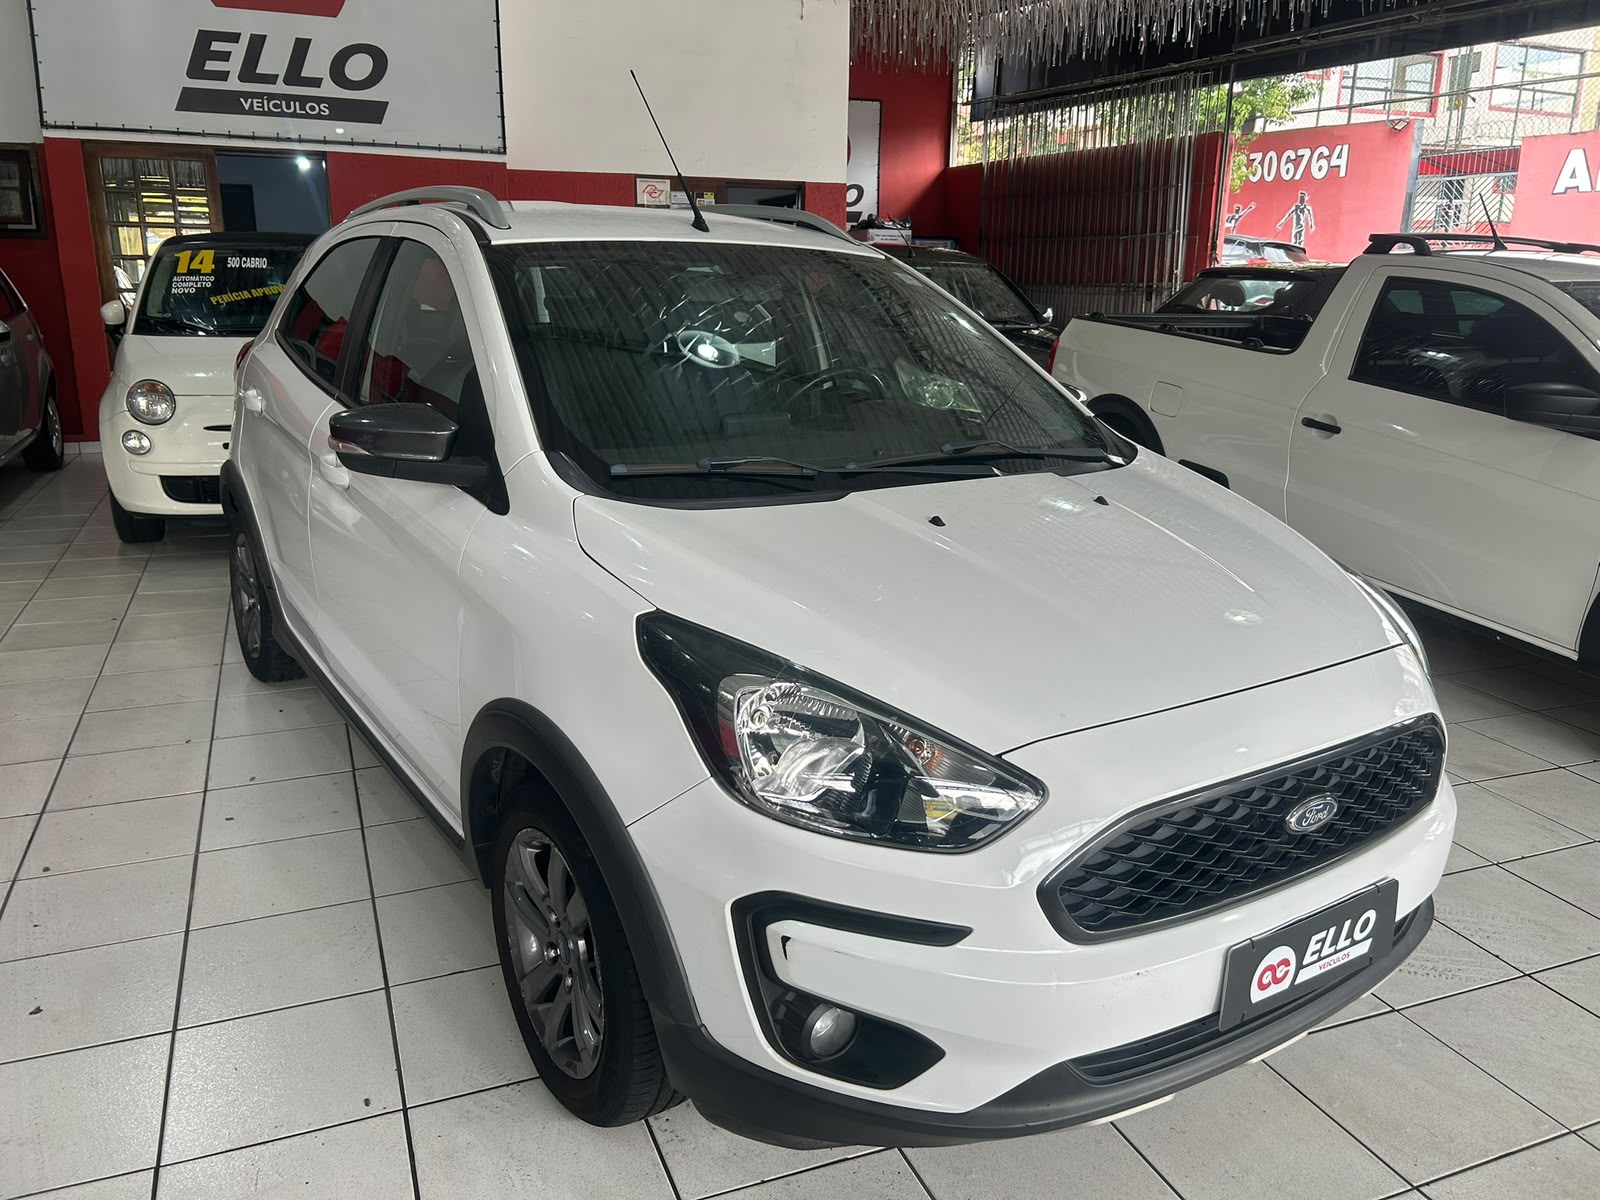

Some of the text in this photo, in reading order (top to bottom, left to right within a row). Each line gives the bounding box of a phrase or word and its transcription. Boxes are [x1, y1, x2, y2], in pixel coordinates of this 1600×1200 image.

[186, 29, 389, 91] ELLO
[240, 96, 330, 116] VEÍCULOS
[1241, 144, 1350, 183] 306764
[174, 249, 216, 274] 14
[227, 257, 268, 269] 500 CABRIO
[172, 274, 215, 282] AUTOMÁTICO
[1302, 804, 1330, 827] Ford
[1302, 909, 1377, 966] ELLO
